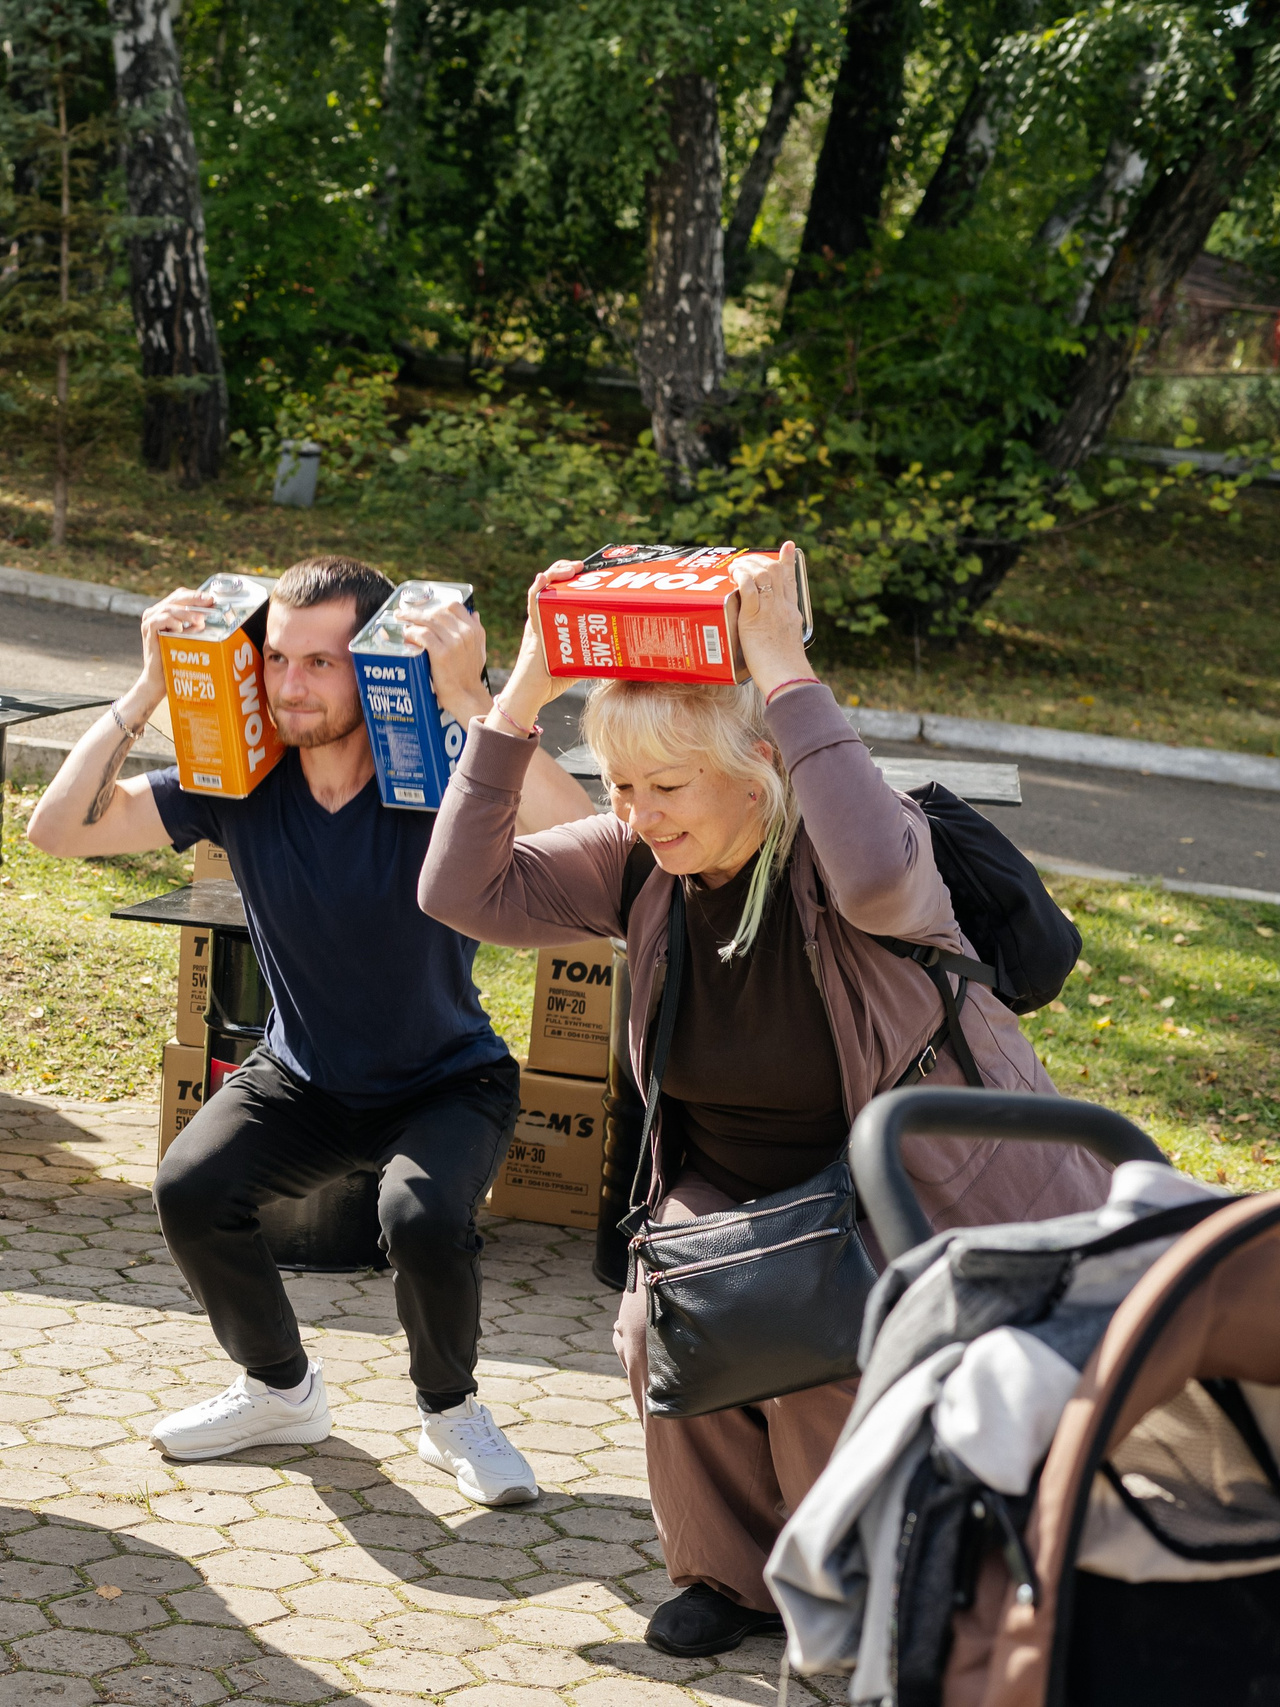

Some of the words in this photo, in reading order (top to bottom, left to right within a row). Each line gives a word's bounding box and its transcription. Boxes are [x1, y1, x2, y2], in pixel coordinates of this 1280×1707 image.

[567, 571, 730, 591] TOM'S
[554, 612, 575, 664] TOM'S
[577, 613, 593, 666] PROFESSIONAL
[587, 613, 613, 667] 5W-30
[170, 649, 210, 666] TOM'S
[364, 665, 406, 682] TOM'S
[173, 678, 216, 700] 0W-20
[232, 641, 266, 774] TOM'S
[367, 694, 413, 715] 10W-40
[547, 996, 586, 1015] 0W-20
[508, 1144, 546, 1164] 5W-30
